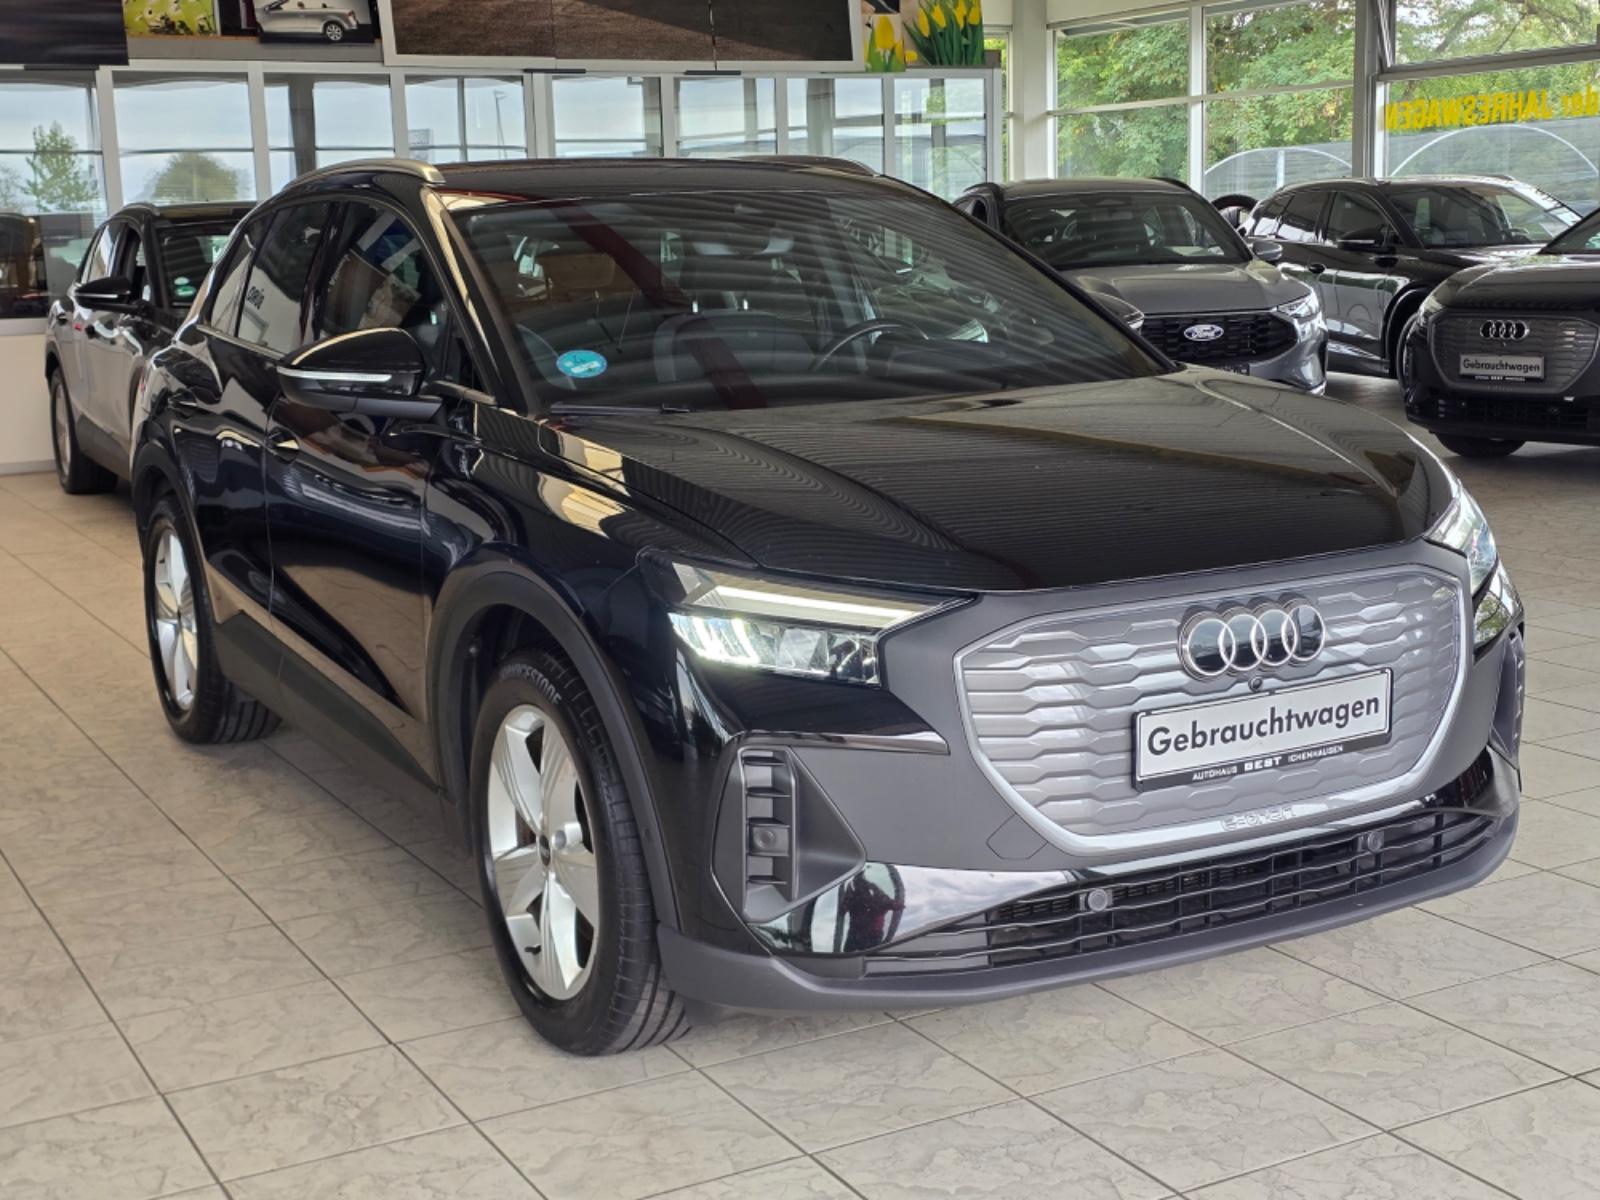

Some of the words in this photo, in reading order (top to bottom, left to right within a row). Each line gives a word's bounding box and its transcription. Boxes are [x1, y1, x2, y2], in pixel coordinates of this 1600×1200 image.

[1463, 358, 1540, 374] Gebrauchtwagen
[1147, 696, 1380, 756] Gebrauchtwagen
[1192, 765, 1238, 781] AUTOHAUS
[1244, 756, 1282, 772] BEST
